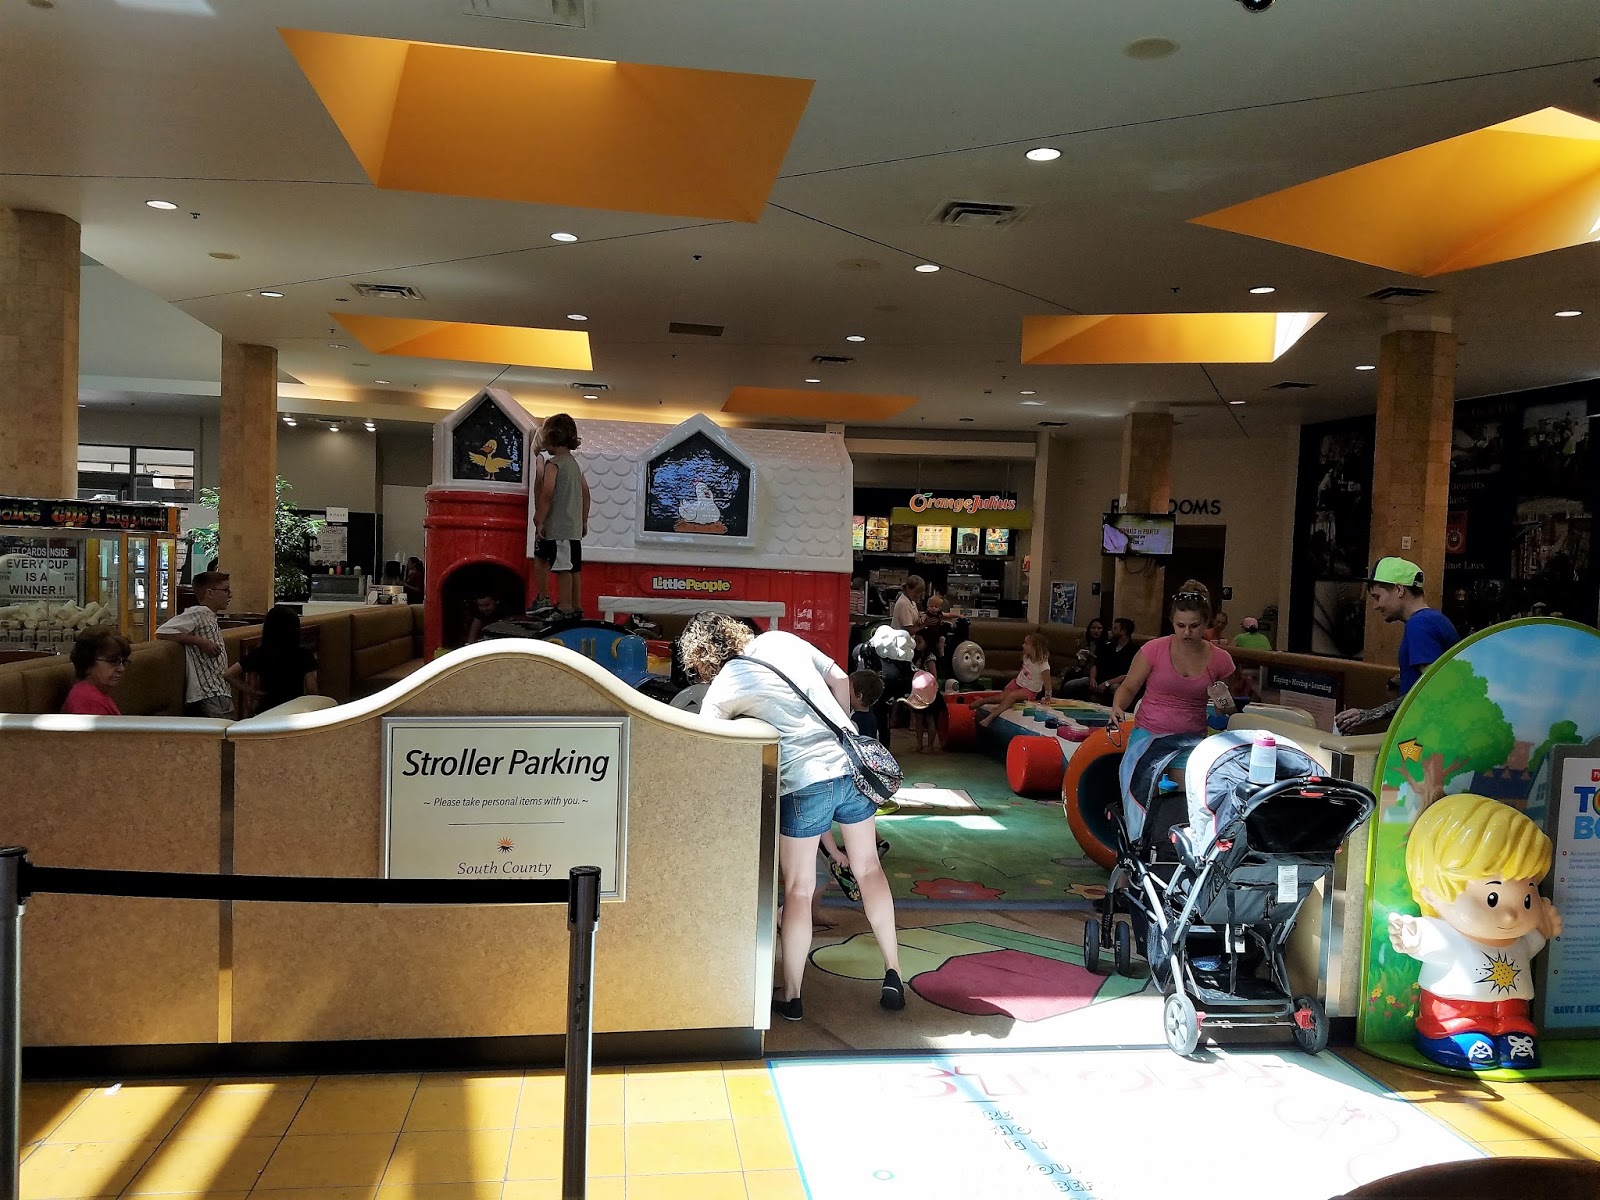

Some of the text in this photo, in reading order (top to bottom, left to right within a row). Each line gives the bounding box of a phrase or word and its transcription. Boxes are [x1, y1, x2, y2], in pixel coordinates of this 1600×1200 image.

[21, 547, 47, 557] CARDS
[48, 548, 69, 557] NSIDE
[6, 559, 69, 569] EVERY CUP
[25, 572, 48, 582] IS A
[9, 585, 56, 595] WINNER
[402, 748, 610, 782] Stroller Parking
[434, 797, 461, 807] Please
[462, 797, 480, 807] take
[481, 796, 518, 808] personal
[519, 796, 543, 806] items
[544, 796, 562, 806] with
[562, 798, 580, 808] you.
[457, 861, 552, 876] South County
